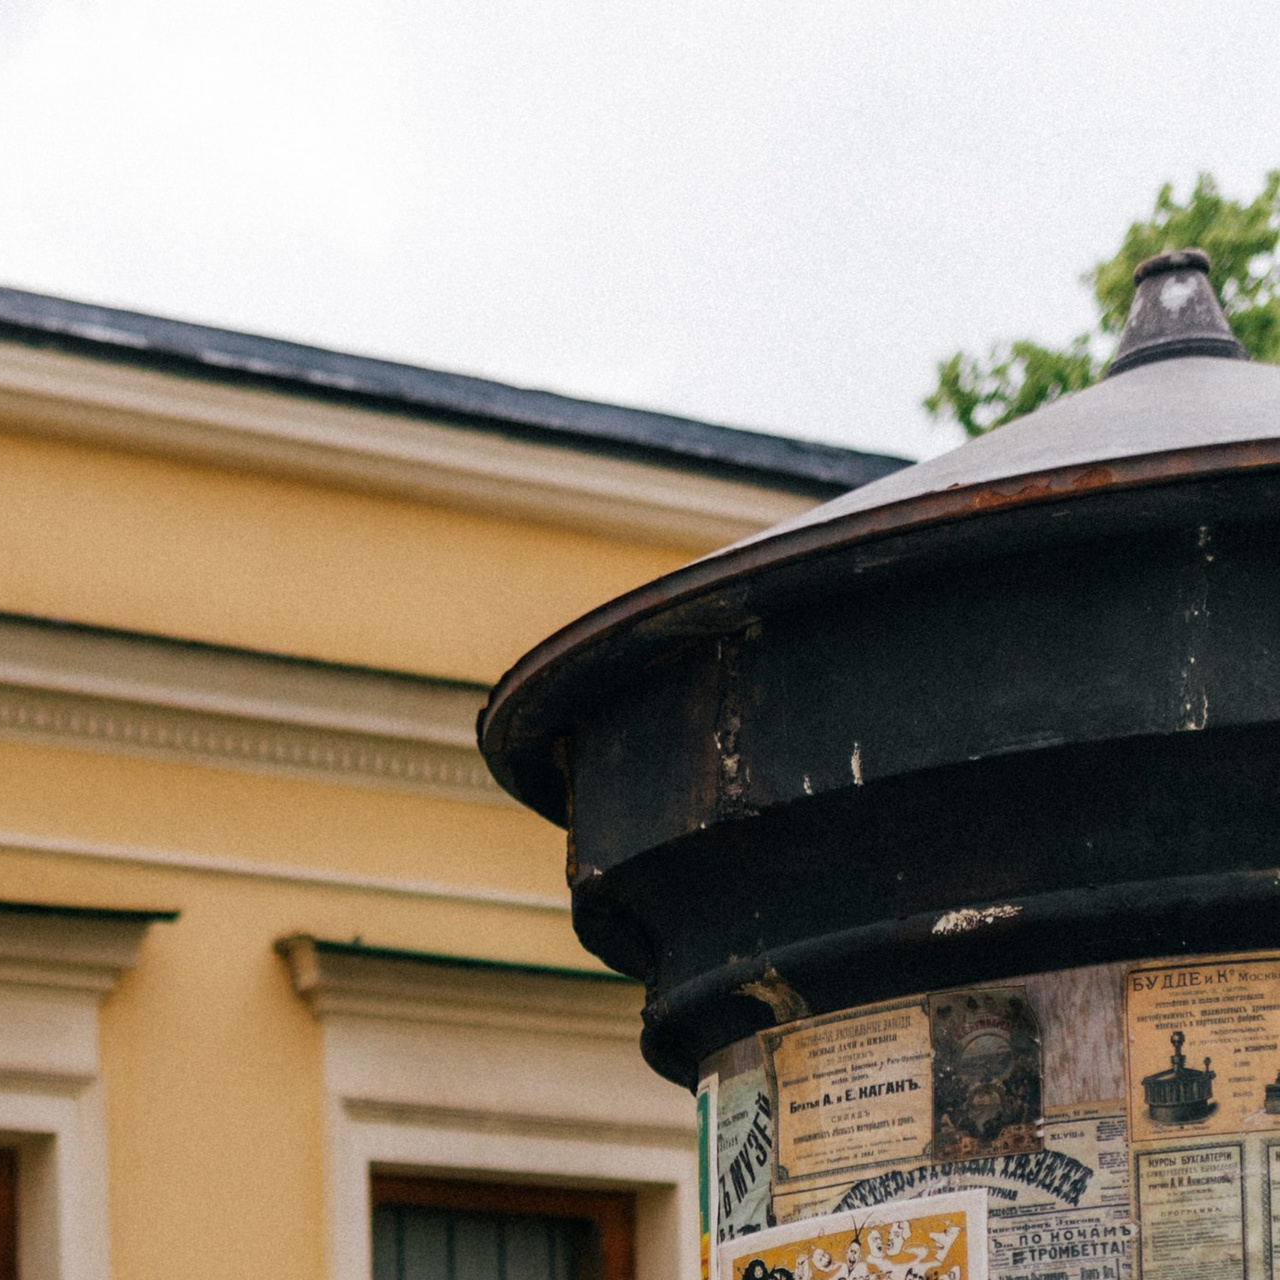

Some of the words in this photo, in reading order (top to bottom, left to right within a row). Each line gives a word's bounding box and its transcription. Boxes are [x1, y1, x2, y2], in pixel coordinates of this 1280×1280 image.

[1132, 971, 1202, 992] БУДДЕ
[823, 1093, 835, 1107] А.
[845, 1088, 857, 1101] Е.
[1019, 1233, 1042, 1246] ПО
[1050, 1223, 1132, 1242] НОЧАМЪ
